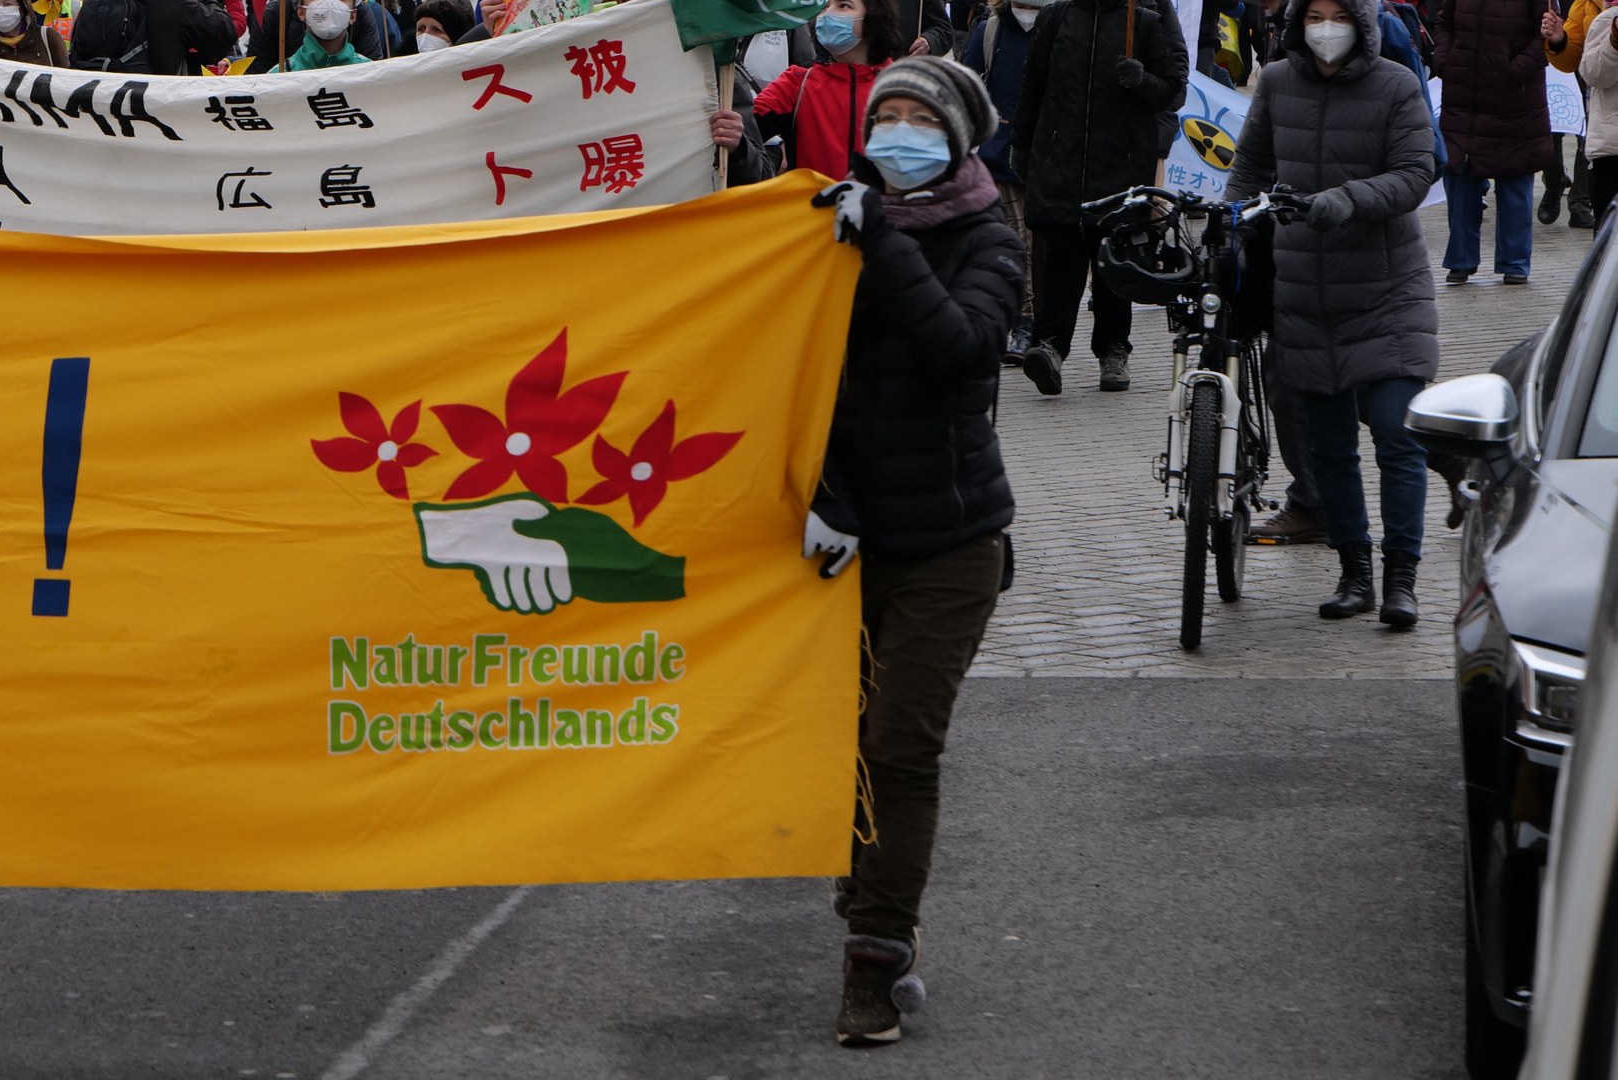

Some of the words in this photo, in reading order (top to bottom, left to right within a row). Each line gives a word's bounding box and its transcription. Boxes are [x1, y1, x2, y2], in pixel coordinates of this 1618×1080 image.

[206, 87, 374, 133] 福島
[216, 164, 376, 211] 広島
[32, 357, 91, 617] !
[328, 630, 687, 692] NaturFreunde
[326, 697, 680, 755] Deutschlands
